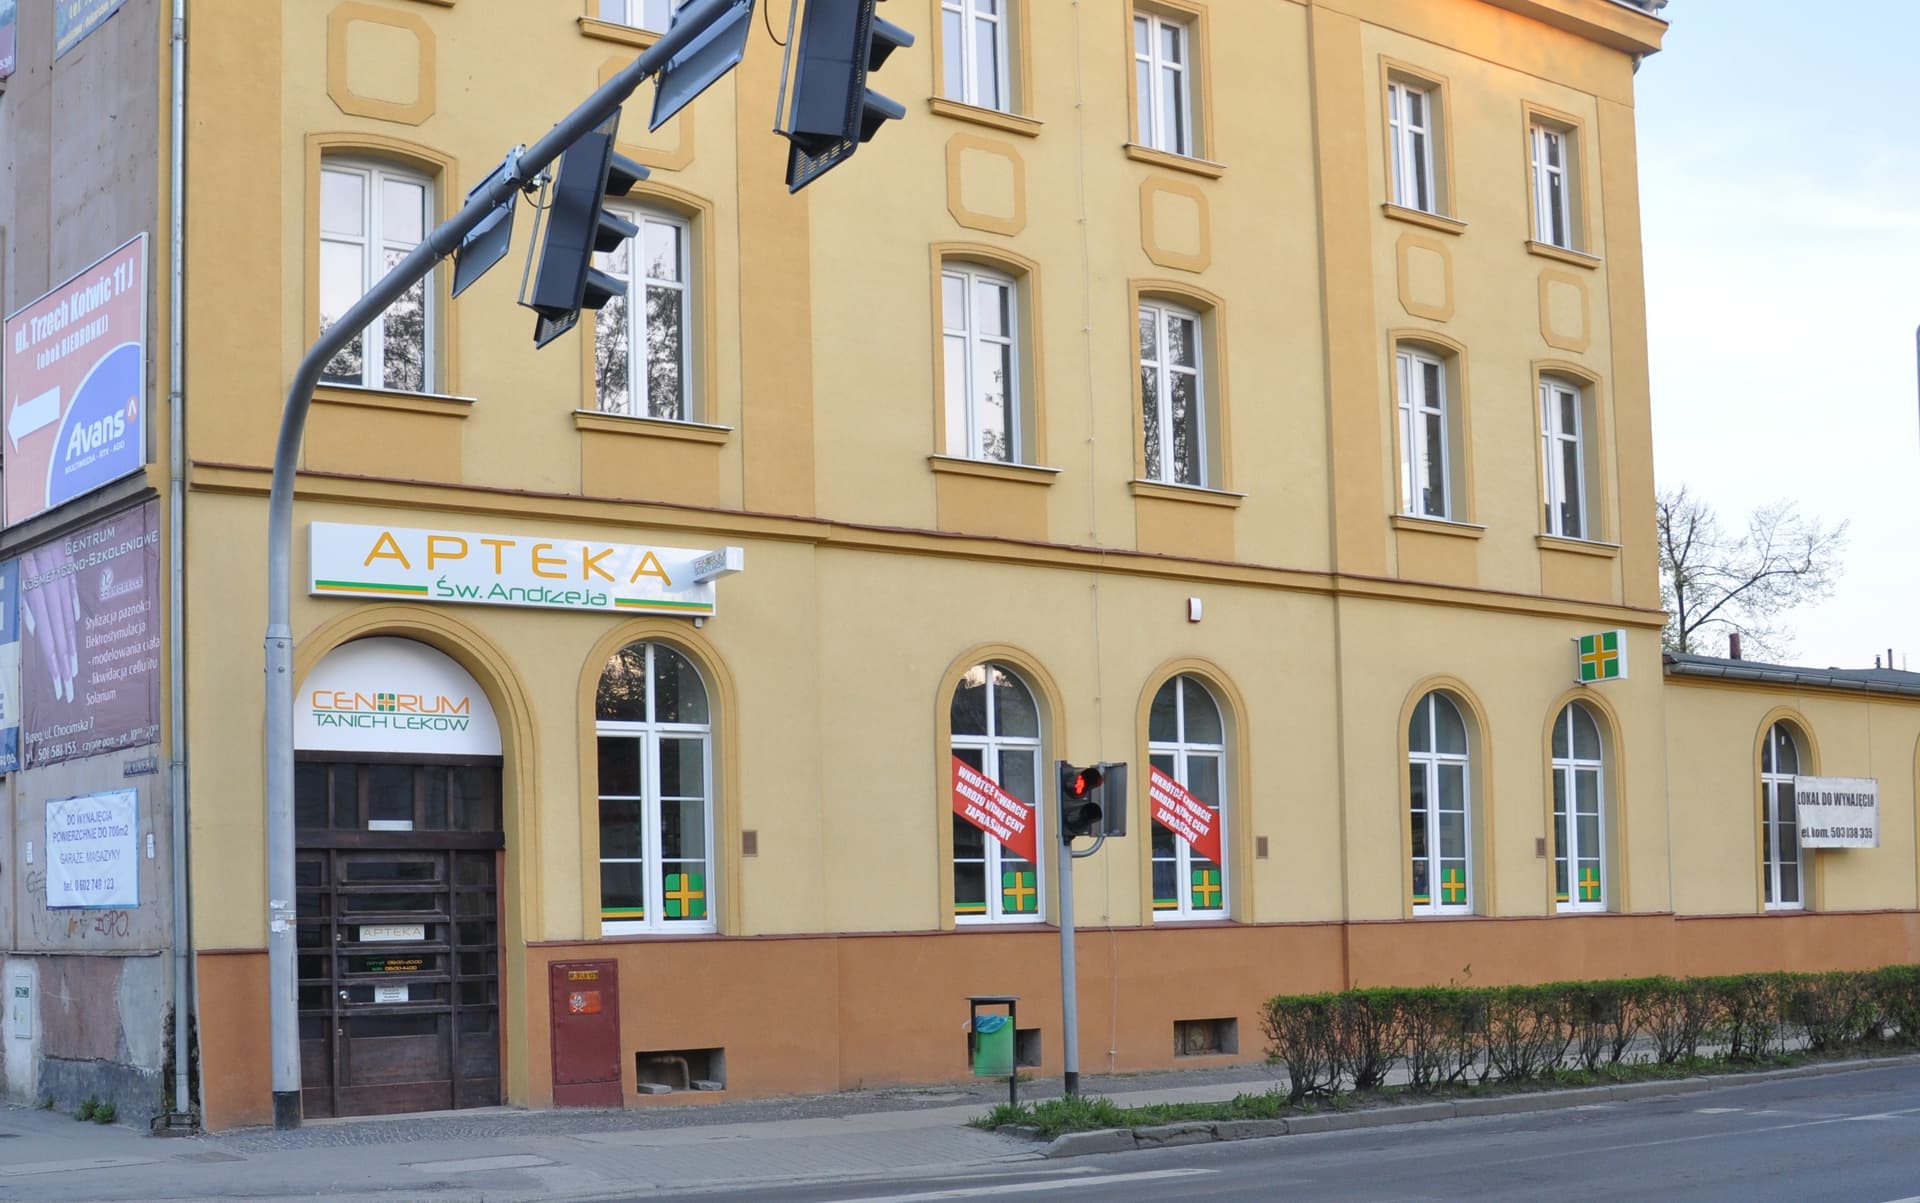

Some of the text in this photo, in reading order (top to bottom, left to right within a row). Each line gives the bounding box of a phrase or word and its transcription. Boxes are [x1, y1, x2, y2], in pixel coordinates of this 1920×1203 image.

[15, 322, 29, 354] ul.
[30, 300, 69, 344] Trzech
[70, 276, 112, 323] Kotwic
[113, 262, 126, 296] 11
[65, 408, 126, 462] Avans
[65, 526, 116, 556] CENTRUM
[363, 531, 672, 587] APTEKA
[436, 574, 608, 607] Św. Andrzeja
[312, 713, 388, 729] TANICH
[64, 740, 77, 755] 153
[1797, 791, 1875, 809] LOKAL DO WYNAJĘCIA
[66, 809, 113, 825] DO WYNAJĘCIA
[1005, 815, 1026, 834] CENY
[98, 825, 107, 838] DO
[1191, 818, 1210, 837] CENY
[363, 927, 422, 937] APTEKA
